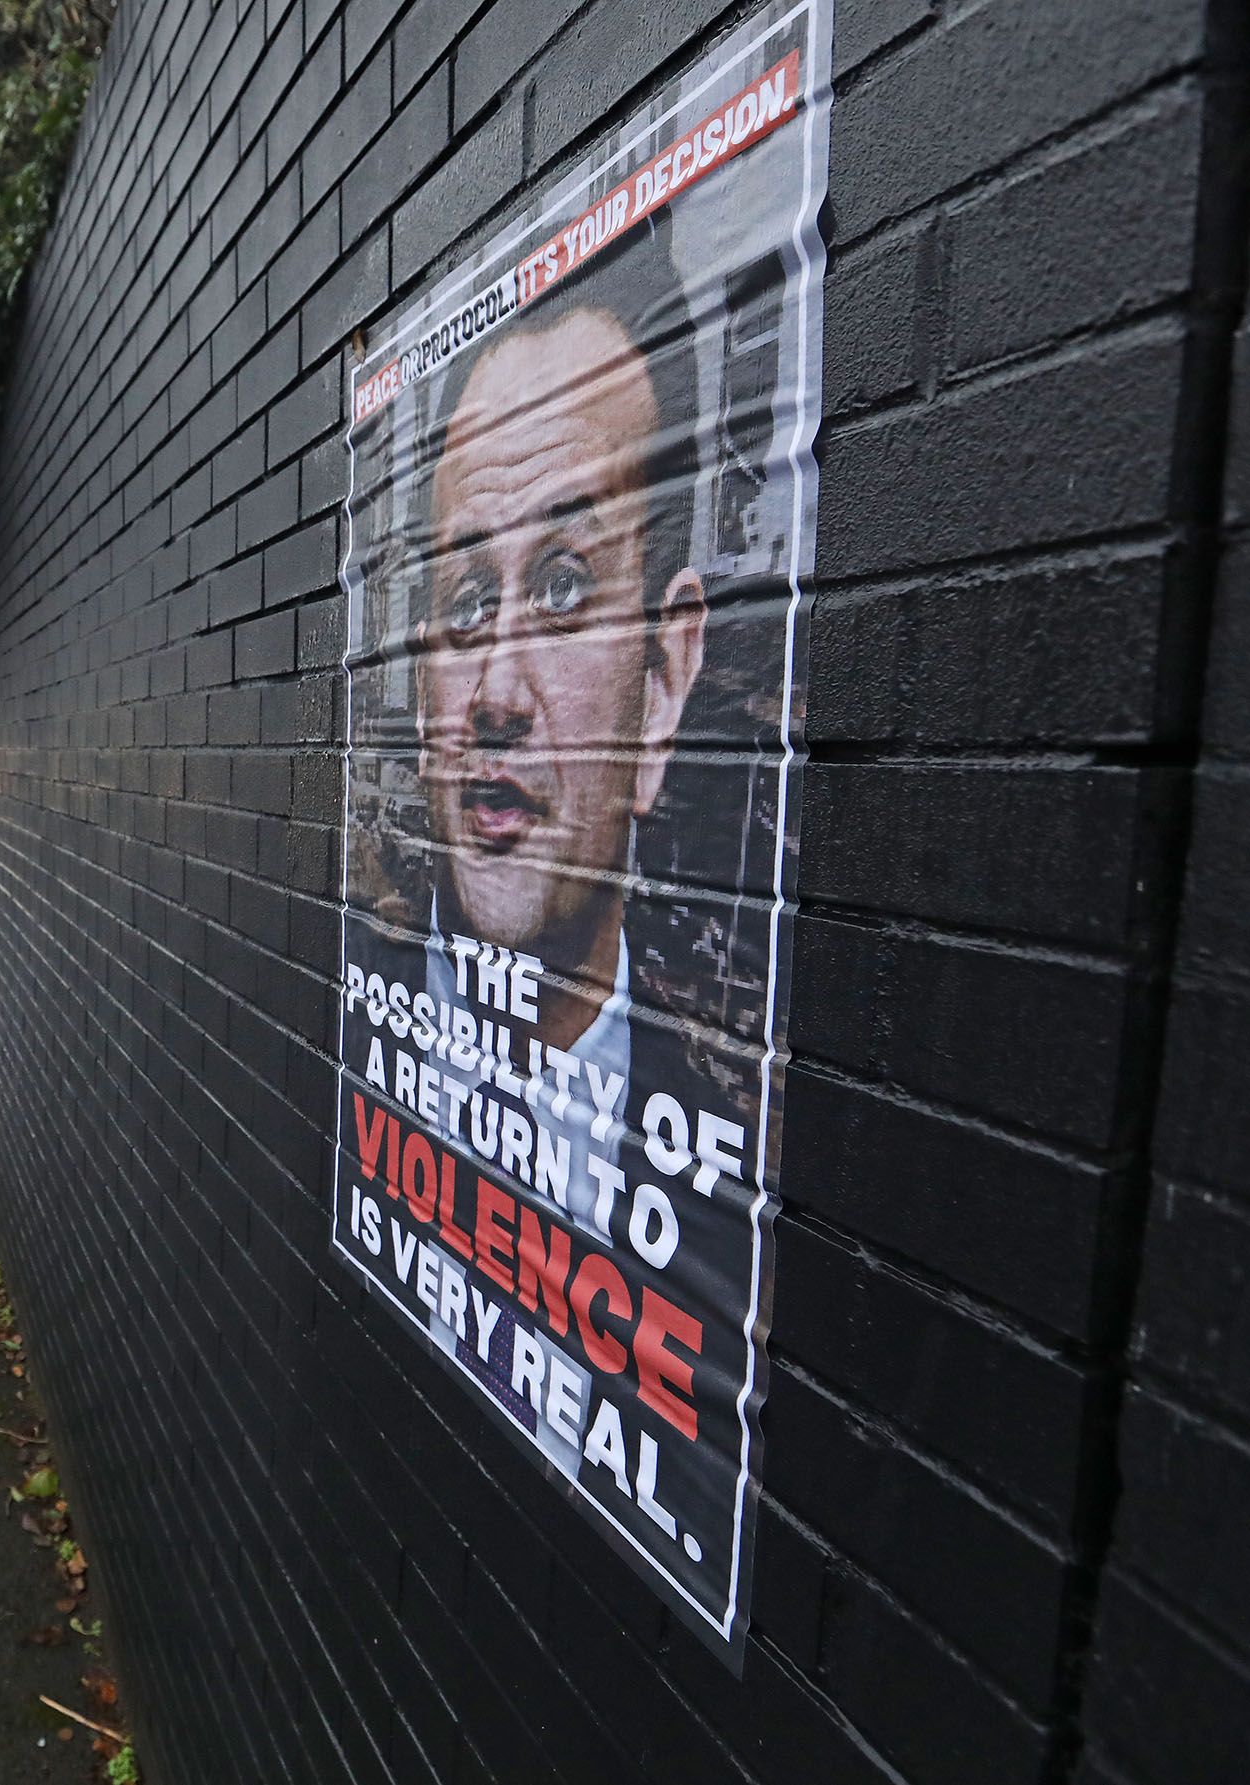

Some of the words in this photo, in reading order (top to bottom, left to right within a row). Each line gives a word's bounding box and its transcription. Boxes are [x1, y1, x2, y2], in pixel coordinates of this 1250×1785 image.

[356, 363, 399, 420] PEACE
[400, 346, 422, 387] OR
[421, 282, 515, 371] PROTOCOL.
[518, 243, 559, 302] IT'S
[563, 189, 629, 269] YOUR
[632, 67, 794, 219] DECISION.
[346, 962, 626, 1143] POSSIBILITY
[643, 1092, 744, 1198] OF
[451, 933, 545, 1024] THE
[353, 1091, 703, 1442] VIOLENCE
[365, 1036, 387, 1094] A
[395, 1048, 570, 1211] RETURN
[588, 1153, 679, 1270] TO
[351, 1184, 382, 1257] IS
[391, 1217, 502, 1364] VERY
[511, 1322, 703, 1563] REAL.
